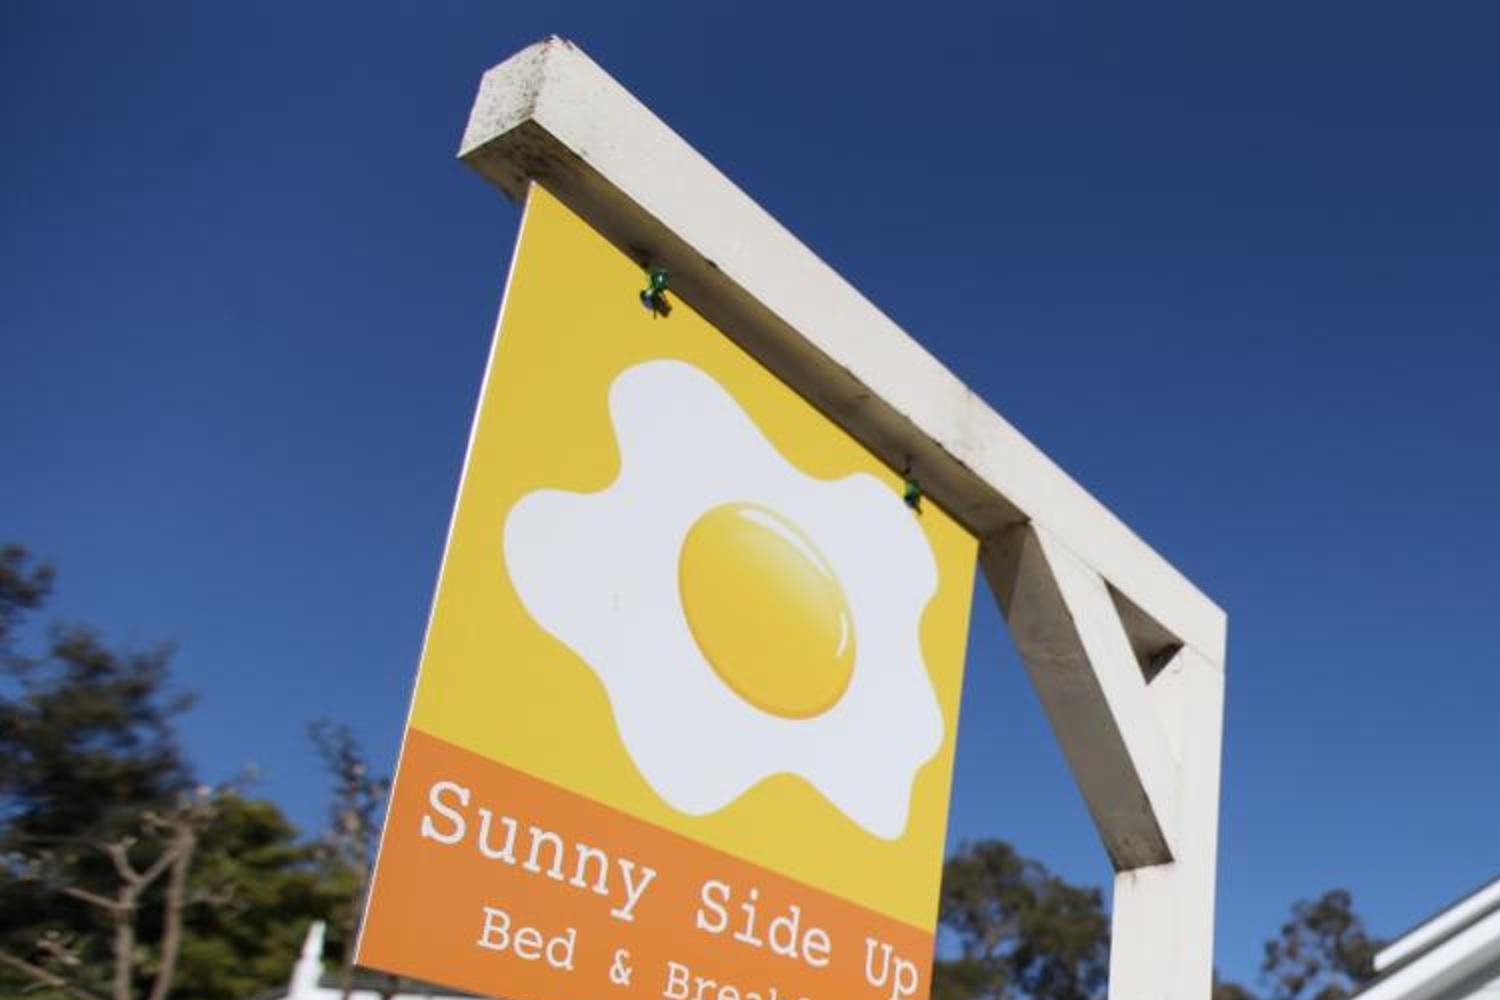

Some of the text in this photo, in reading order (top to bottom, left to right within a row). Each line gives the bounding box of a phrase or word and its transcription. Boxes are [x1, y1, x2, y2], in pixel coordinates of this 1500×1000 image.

[421, 781, 656, 922] Sunny
[696, 880, 831, 967] Side
[478, 907, 576, 970] Bed
[609, 949, 631, 985] &
